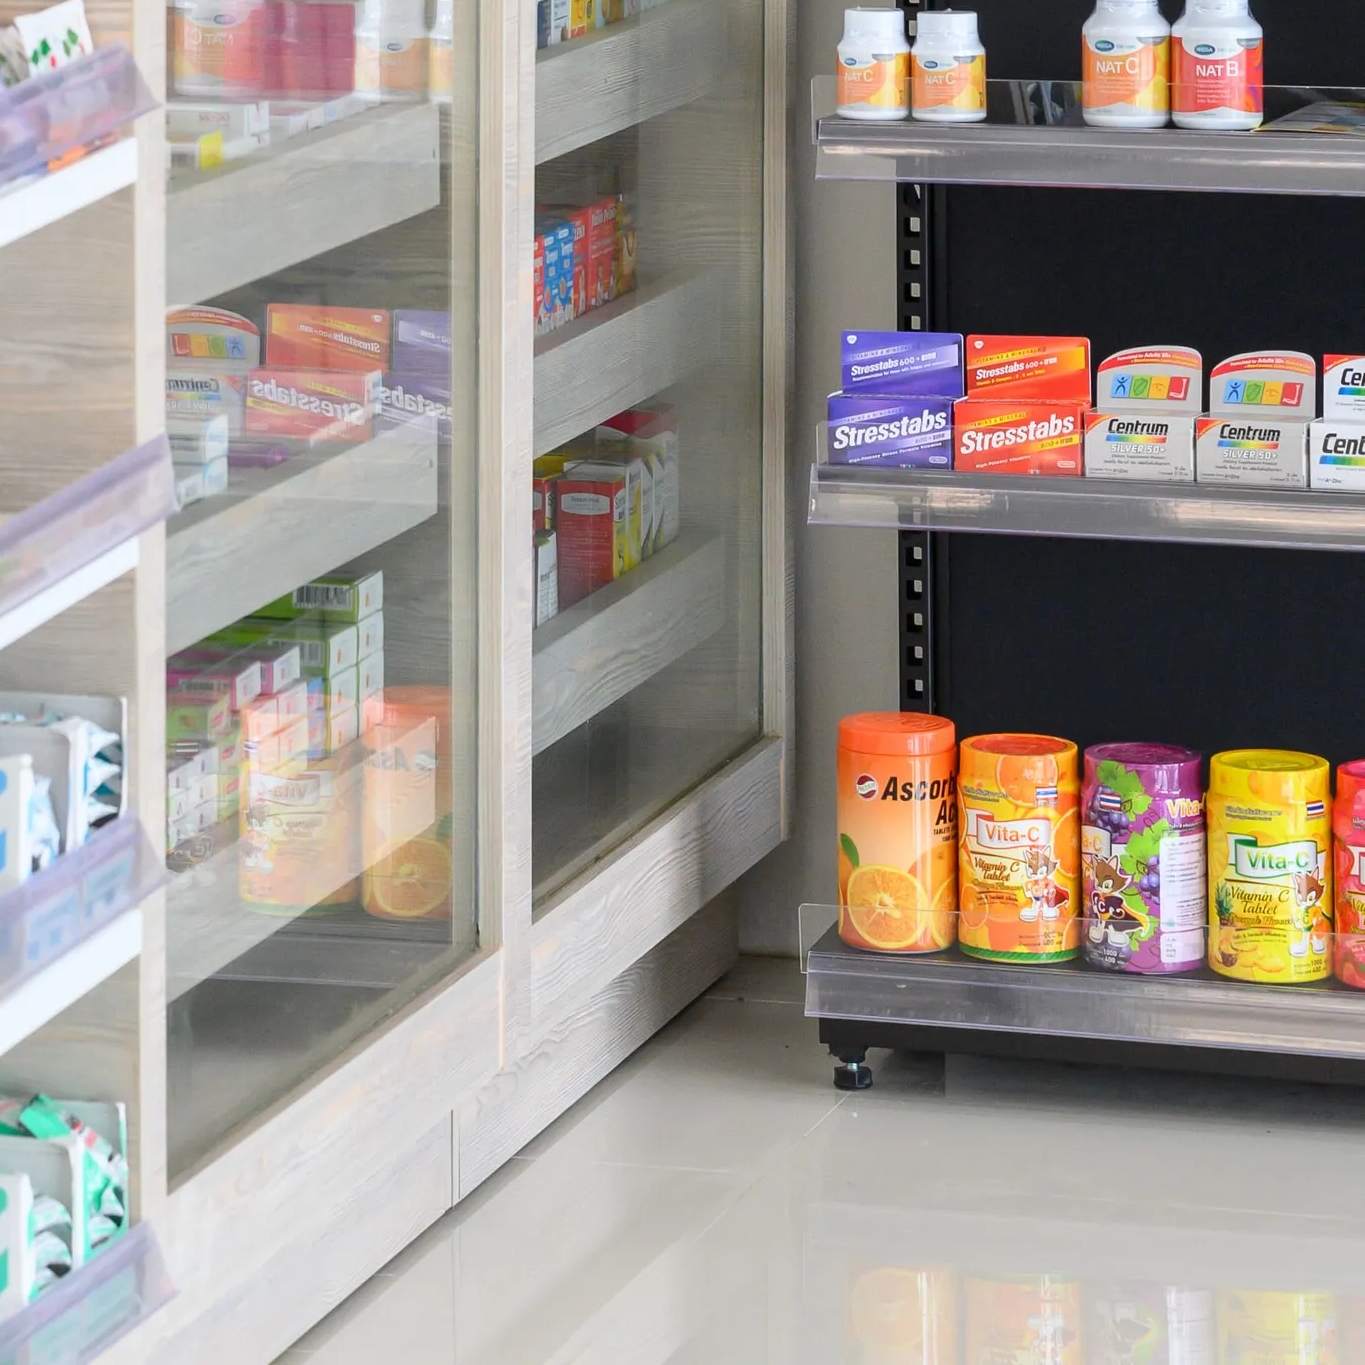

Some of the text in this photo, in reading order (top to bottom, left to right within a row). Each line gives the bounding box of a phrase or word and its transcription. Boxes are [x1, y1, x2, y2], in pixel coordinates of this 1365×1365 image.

[1096, 57, 1139, 75] NAT C
[1196, 60, 1239, 77] NAT B
[844, 69, 874, 83] NAT C
[924, 71, 956, 86] NAT C
[850, 356, 915, 377] Stresstabs 600
[975, 359, 1039, 381] Stresstabs 600
[833, 409, 947, 450] Stresstabs
[960, 416, 1075, 455] Stresstabs
[1107, 418, 1169, 437] Centrum
[1219, 423, 1281, 443] Centrum
[1110, 443, 1167, 455] SILVER 50+
[1222, 449, 1278, 461] SILVER 50+
[985, 823, 1040, 843] Vita-C
[974, 857, 1021, 873] Vitamin C
[1246, 850, 1311, 871] Vita-C
[982, 870, 1011, 882] Tablet
[1230, 885, 1291, 903] Vitamin C
[1241, 901, 1278, 916] Tablet
